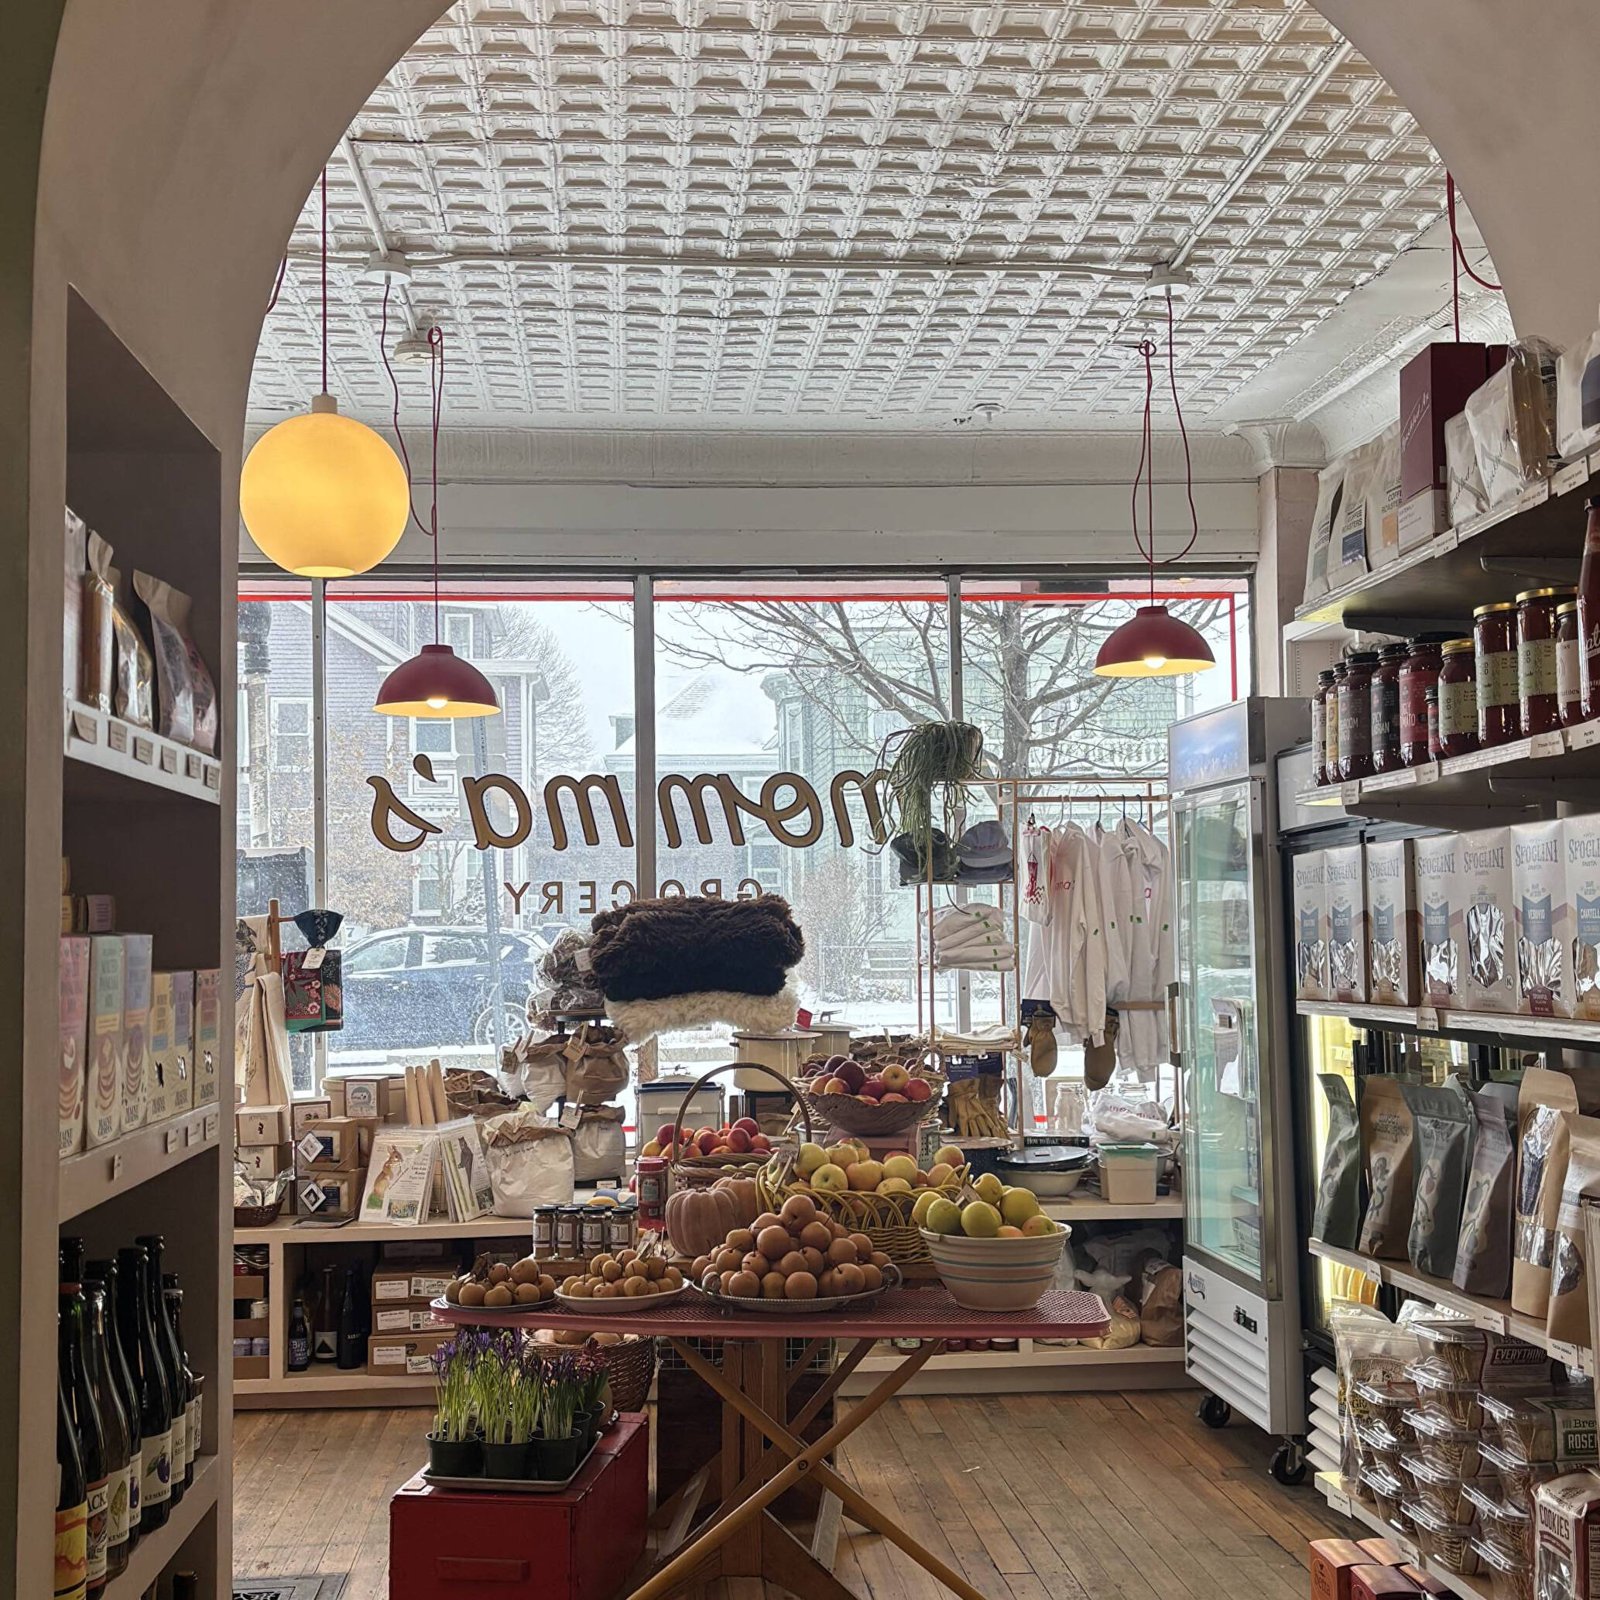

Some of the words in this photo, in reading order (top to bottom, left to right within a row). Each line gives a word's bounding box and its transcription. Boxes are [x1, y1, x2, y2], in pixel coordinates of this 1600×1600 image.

[1417, 852, 1456, 877] SFOGLINI
[1463, 846, 1505, 873] SFOGLINI
[1515, 839, 1559, 867] SFOGLINI
[1539, 1503, 1570, 1540] COOKIES
